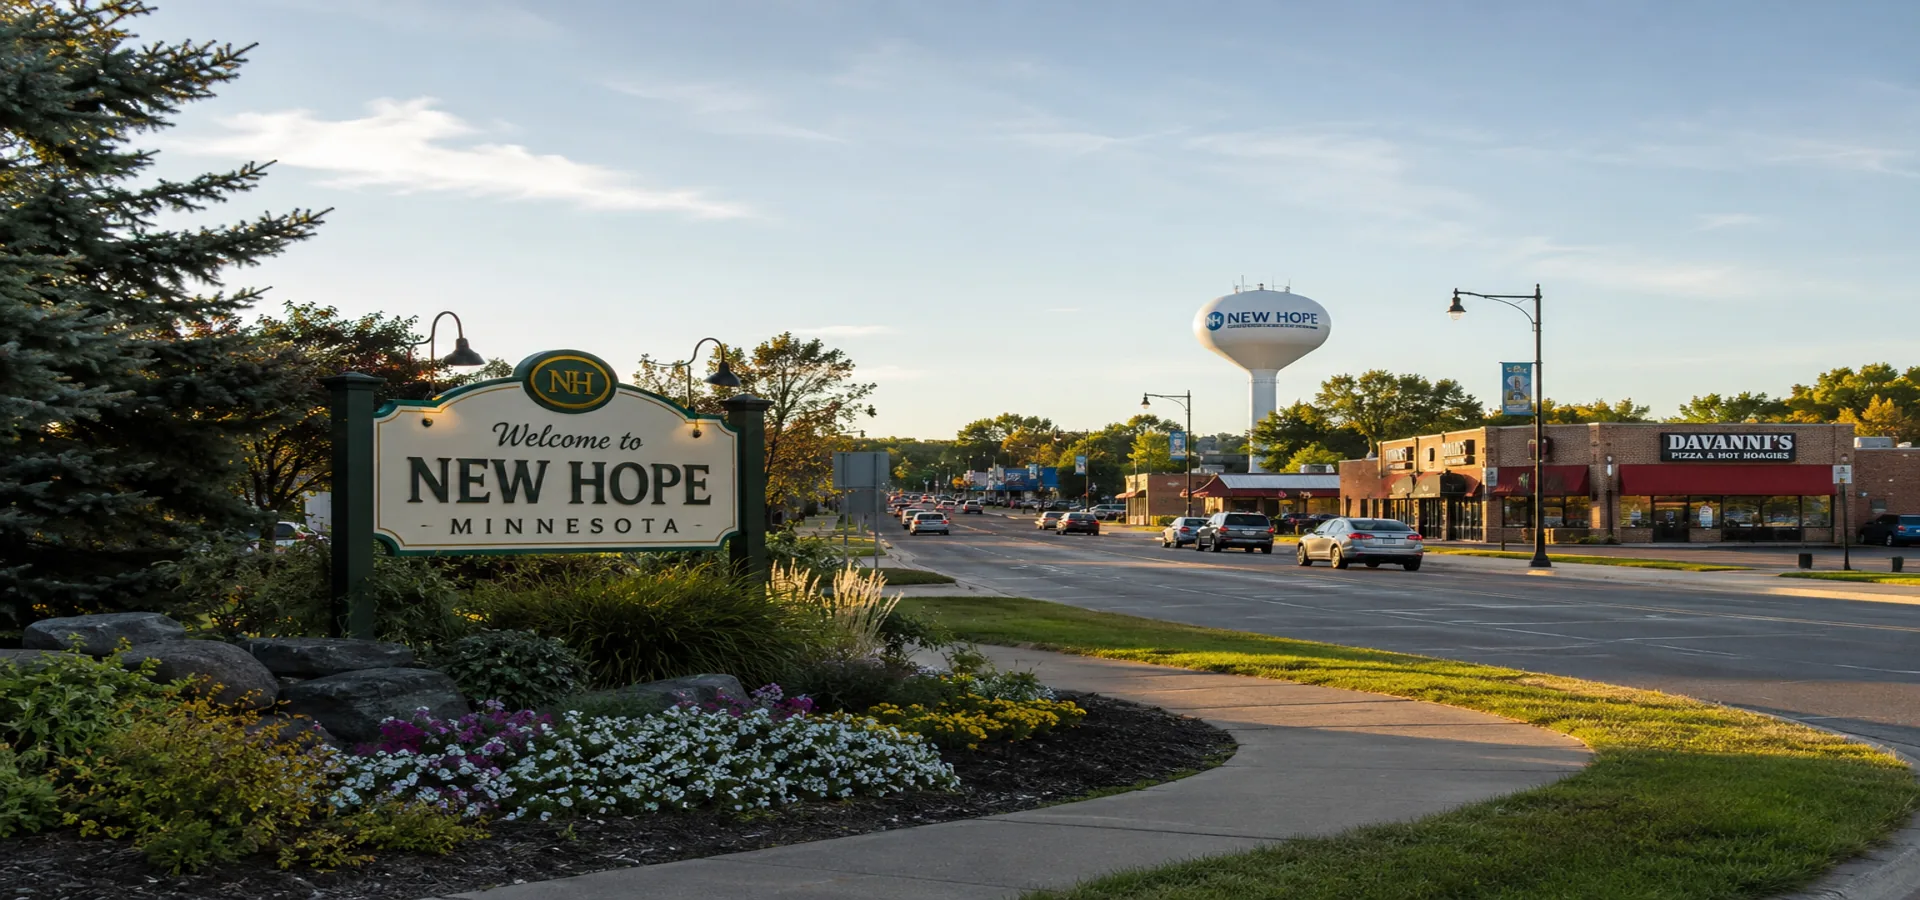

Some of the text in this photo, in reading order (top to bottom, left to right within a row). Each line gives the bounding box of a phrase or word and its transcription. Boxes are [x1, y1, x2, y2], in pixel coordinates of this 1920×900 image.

[1227, 311, 1319, 325] NEW HOPE
[548, 369, 595, 395] NH
[492, 422, 643, 451] Welcome to
[1668, 434, 1793, 450] DAVANNI'S
[407, 456, 712, 506] NEW HOPE
[450, 517, 679, 535] MINNESOTA
